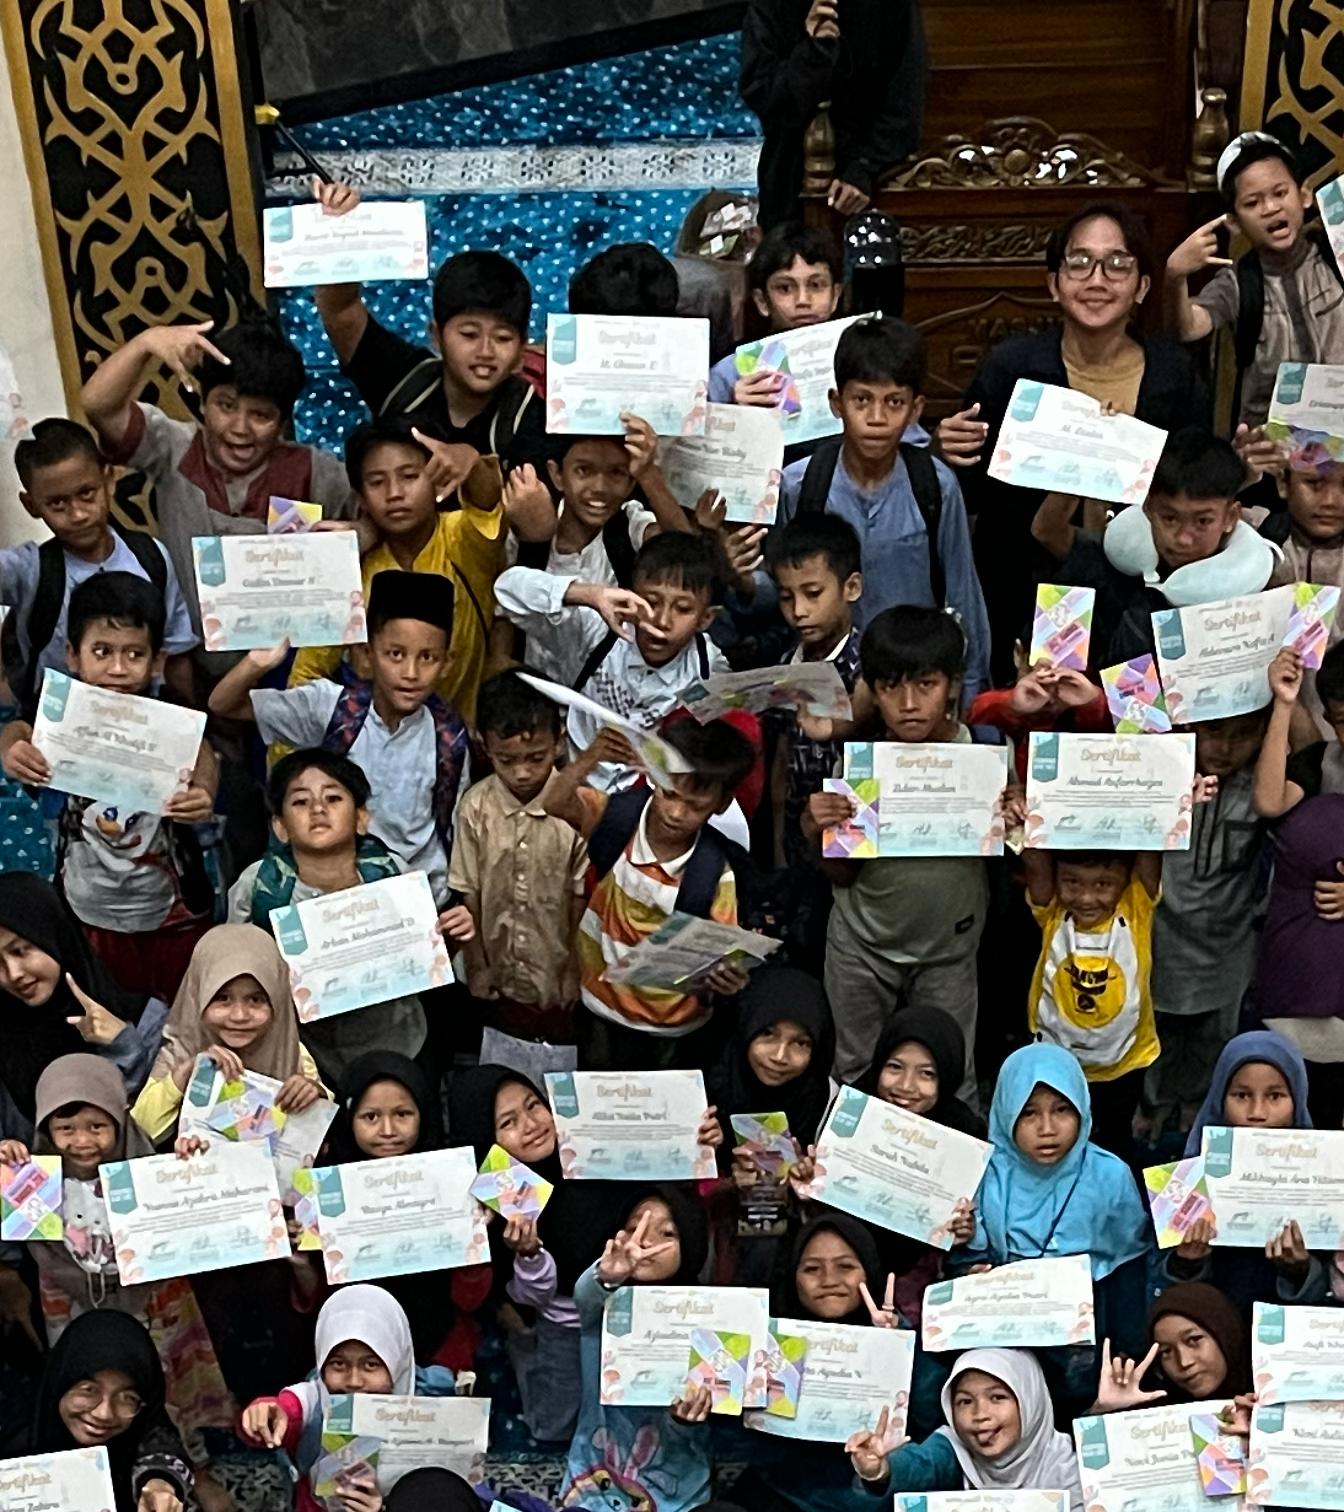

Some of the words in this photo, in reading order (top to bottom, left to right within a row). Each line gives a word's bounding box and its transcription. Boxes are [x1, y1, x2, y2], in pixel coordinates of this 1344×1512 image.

[1204, 611, 1261, 632] Sertifikat
[896, 755, 953, 773] Sertifikat
[1080, 748, 1141, 767] Sertifikat
[322, 899, 379, 923] Sertifikat
[597, 1084, 651, 1102] Sertifikat
[881, 1118, 938, 1150] Sertifikat
[1256, 1143, 1317, 1161] Sertifikat
[156, 1162, 217, 1184] Sertifikat
[364, 1170, 425, 1191] Sertifikat
[654, 1300, 714, 1320] Sertifikat
[375, 1407, 436, 1426] Sertifikat
